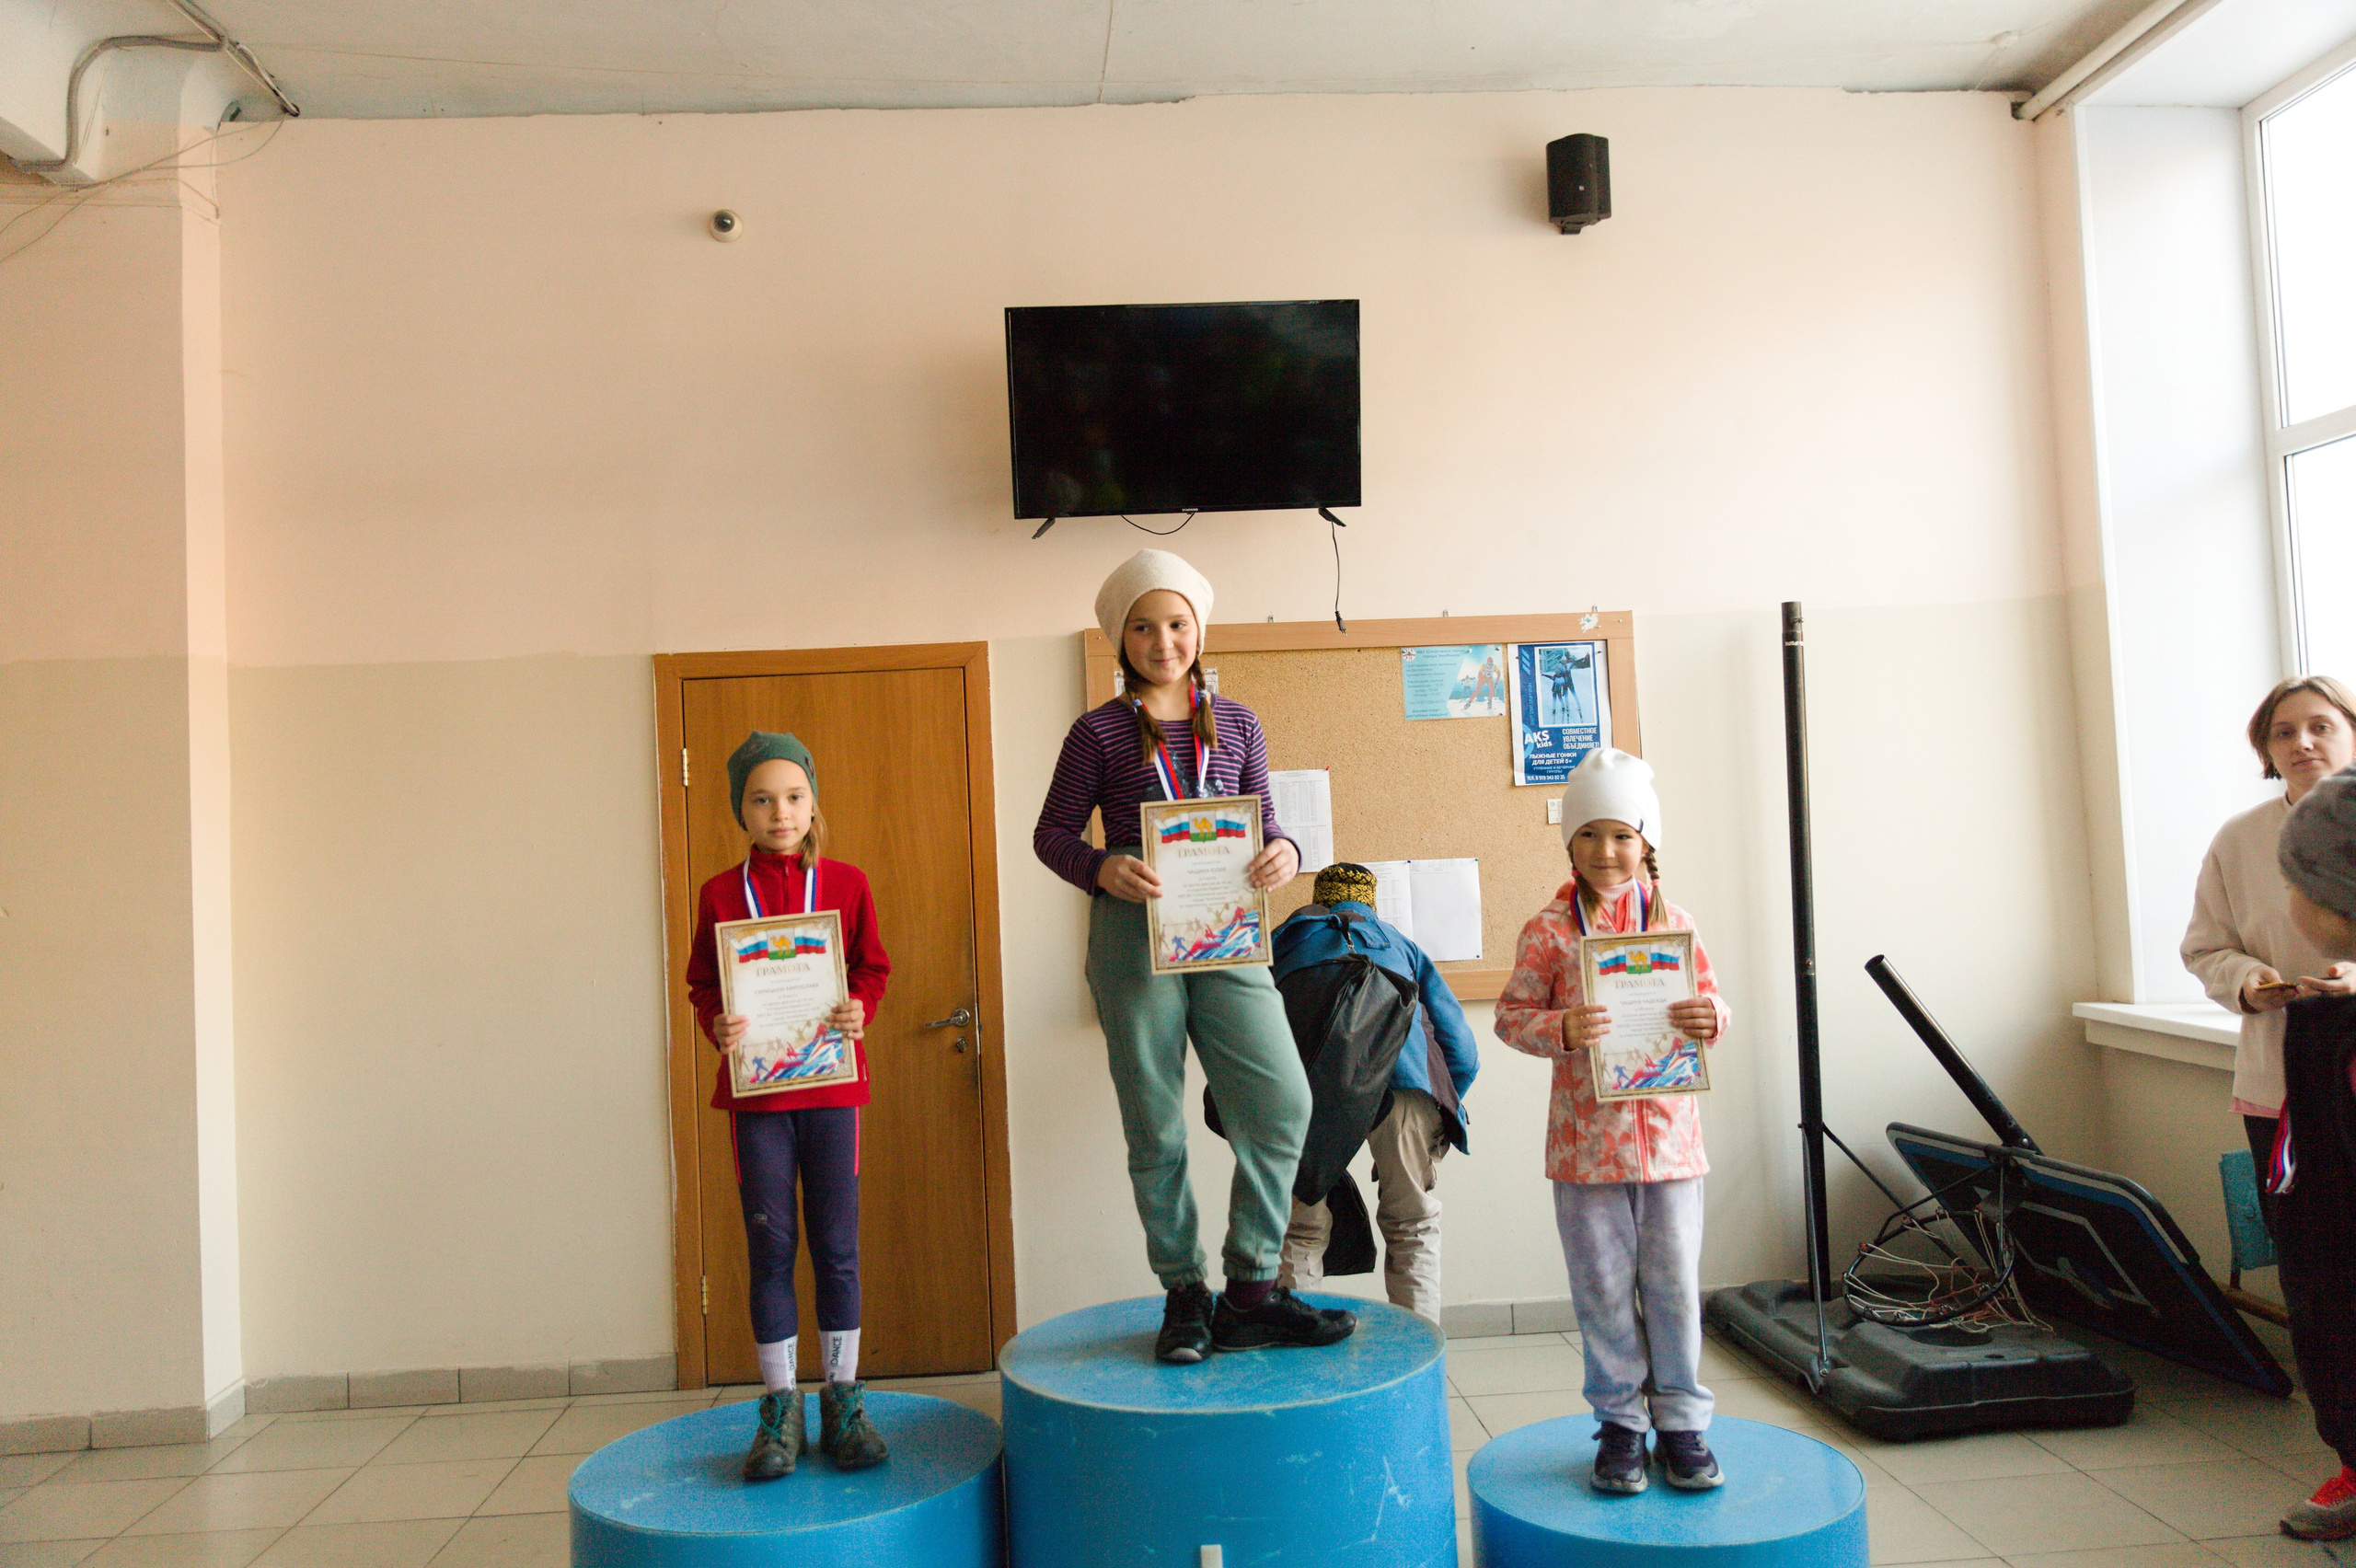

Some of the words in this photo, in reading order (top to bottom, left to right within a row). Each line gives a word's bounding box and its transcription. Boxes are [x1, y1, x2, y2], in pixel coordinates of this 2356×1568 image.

[1524, 730, 1550, 744] AKS
[1178, 846, 1230, 857] ГРАМОТА
[756, 963, 810, 976] ГРАМОТА
[786, 983, 819, 991] МИРОСЛАВА
[1615, 978, 1665, 989] ГРАМОТА
[831, 1336, 842, 1366] DANCE
